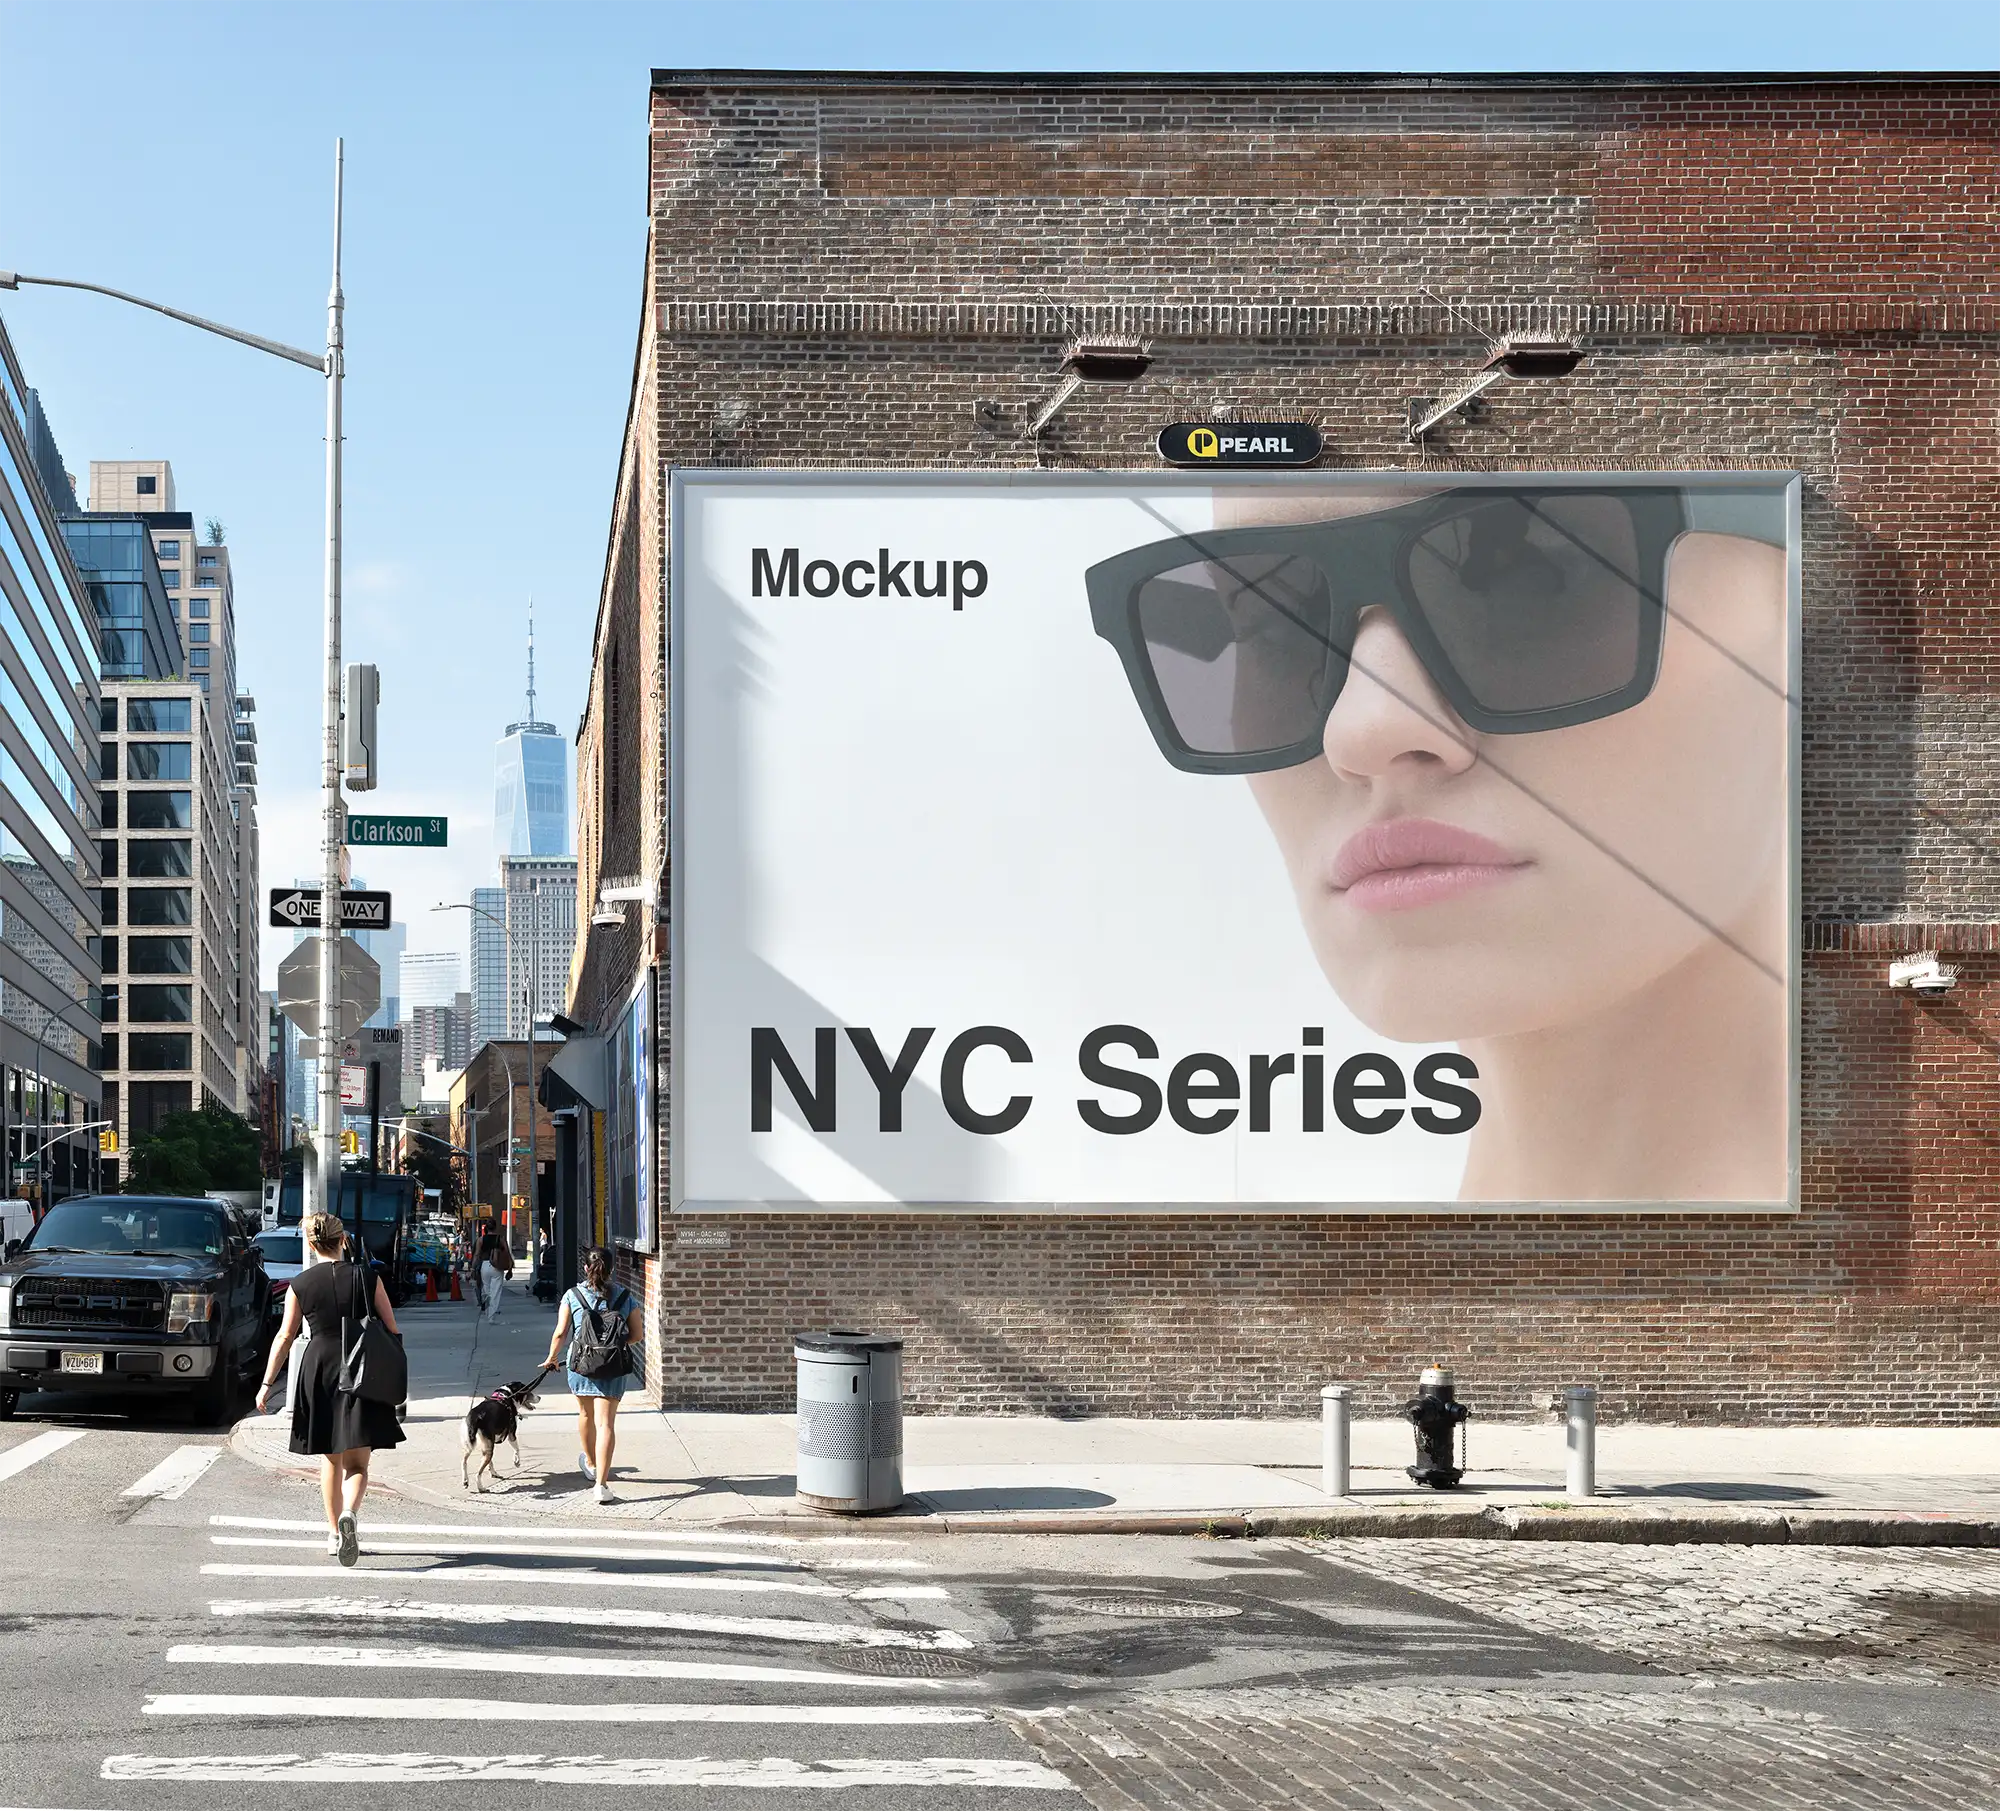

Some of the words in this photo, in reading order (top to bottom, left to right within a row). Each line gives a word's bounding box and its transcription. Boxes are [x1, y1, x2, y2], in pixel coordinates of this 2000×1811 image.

[1220, 437, 1294, 453] PEARL
[752, 548, 988, 611] Mockup
[352, 819, 423, 842] Clarkson
[430, 819, 441, 833] St
[286, 901, 321, 916] ONE
[341, 902, 380, 918] WAY
[752, 1025, 1034, 1135] NYC
[1077, 1024, 1482, 1135] Series
